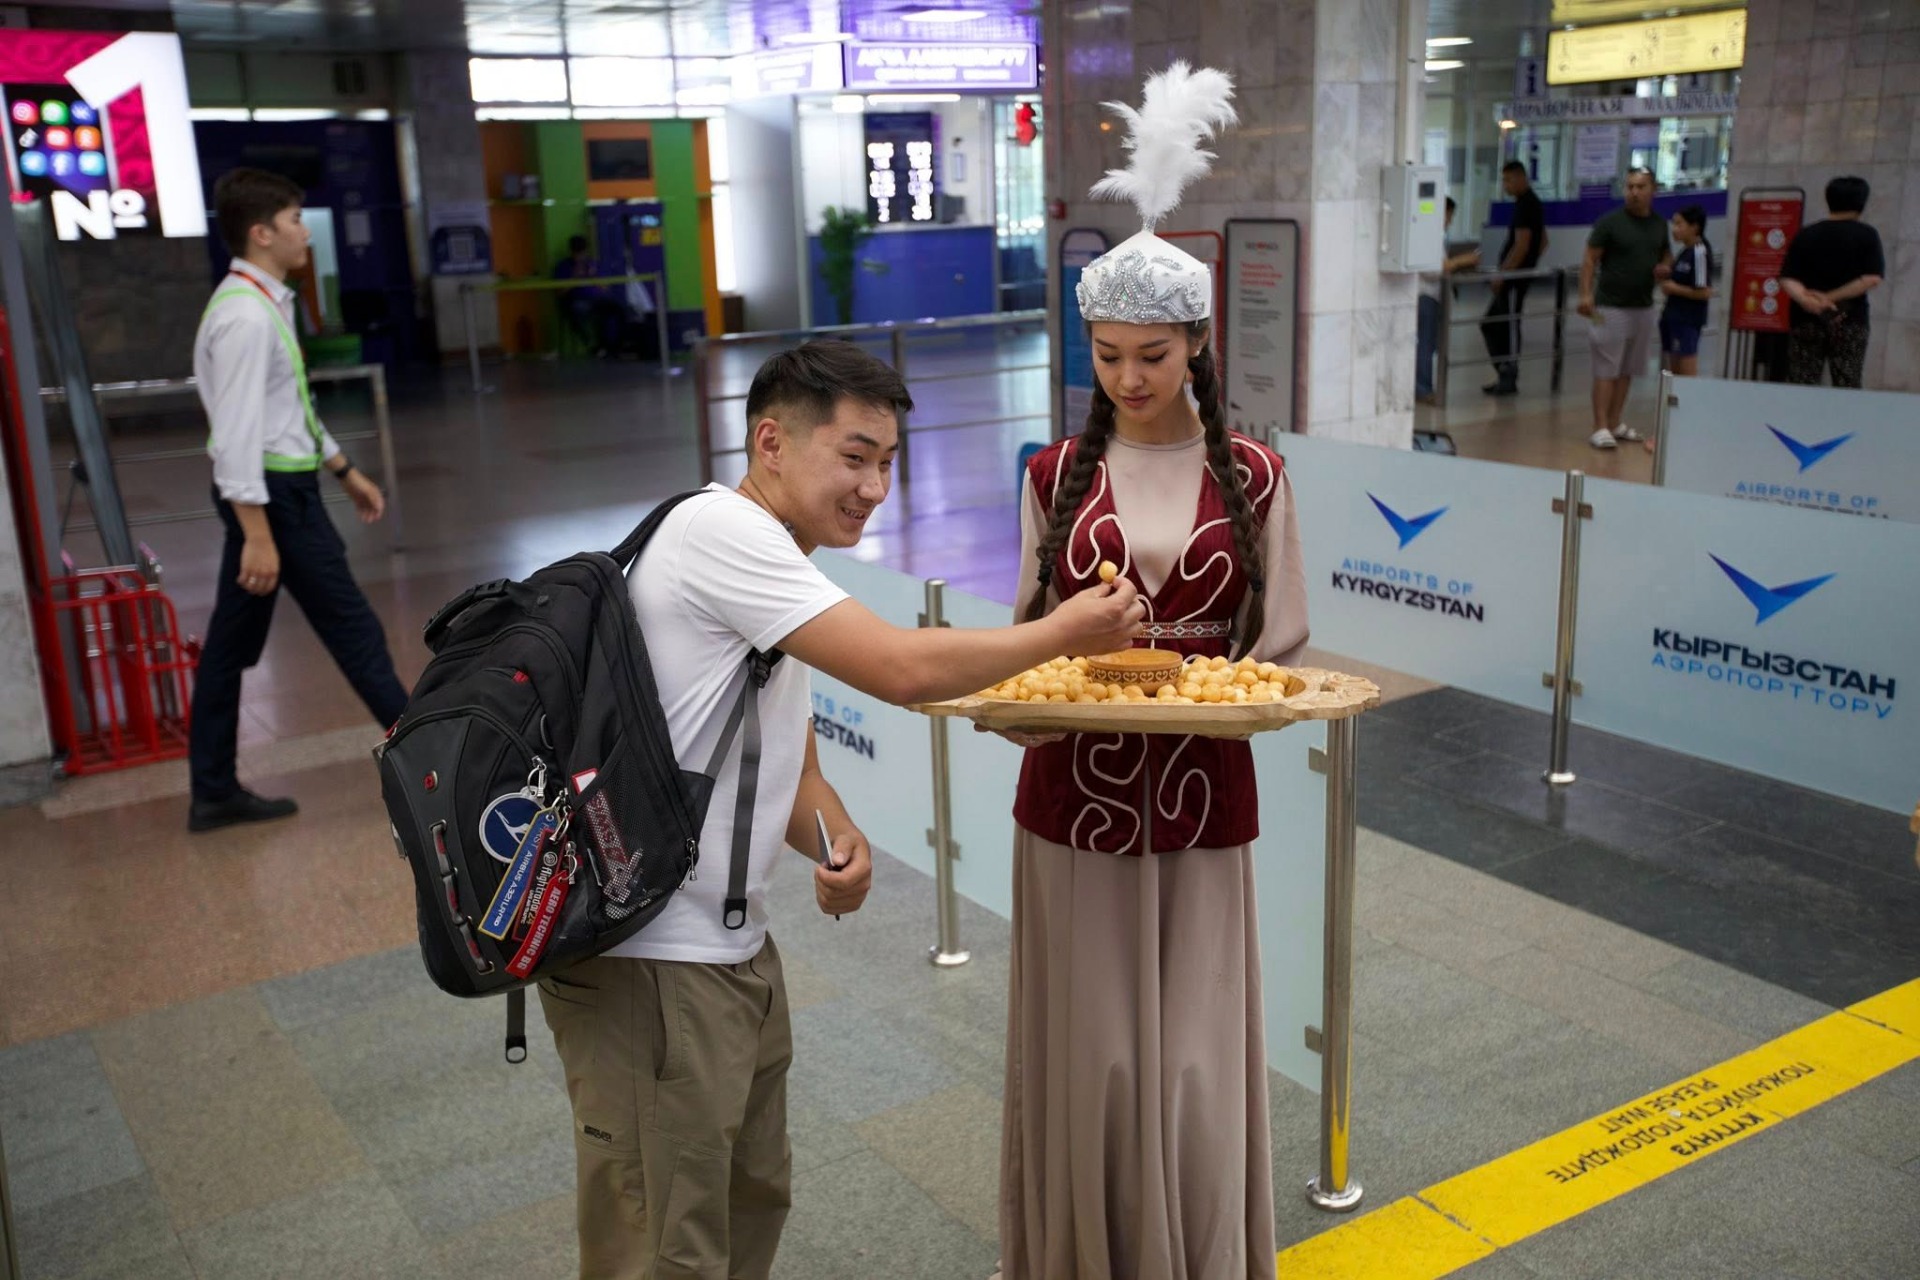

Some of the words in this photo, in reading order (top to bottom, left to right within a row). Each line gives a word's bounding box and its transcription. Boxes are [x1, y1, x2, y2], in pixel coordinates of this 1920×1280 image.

[1735, 480, 1840, 506] AIRPORTS
[1851, 495, 1878, 509] OF
[1342, 557, 1438, 590] AIRPORTS
[1447, 579, 1473, 595] OF
[1332, 571, 1484, 622] KYRGYZSTAN
[1653, 628, 1896, 700] КЫРГЫЗСТАН
[1651, 652, 1892, 719] АЭРОПОРТТОРУ
[842, 706, 864, 725] OF
[514, 850, 533, 882] AIRBUS
[548, 887, 562, 912] AERO
[529, 911, 552, 956] TECHNIC
[516, 956, 532, 970] BG
[1645, 1078, 1719, 1113] PLEASE
[1599, 1105, 1651, 1134] WAIT
[1546, 1119, 1686, 1183] ПОДОЖДИТЕ
